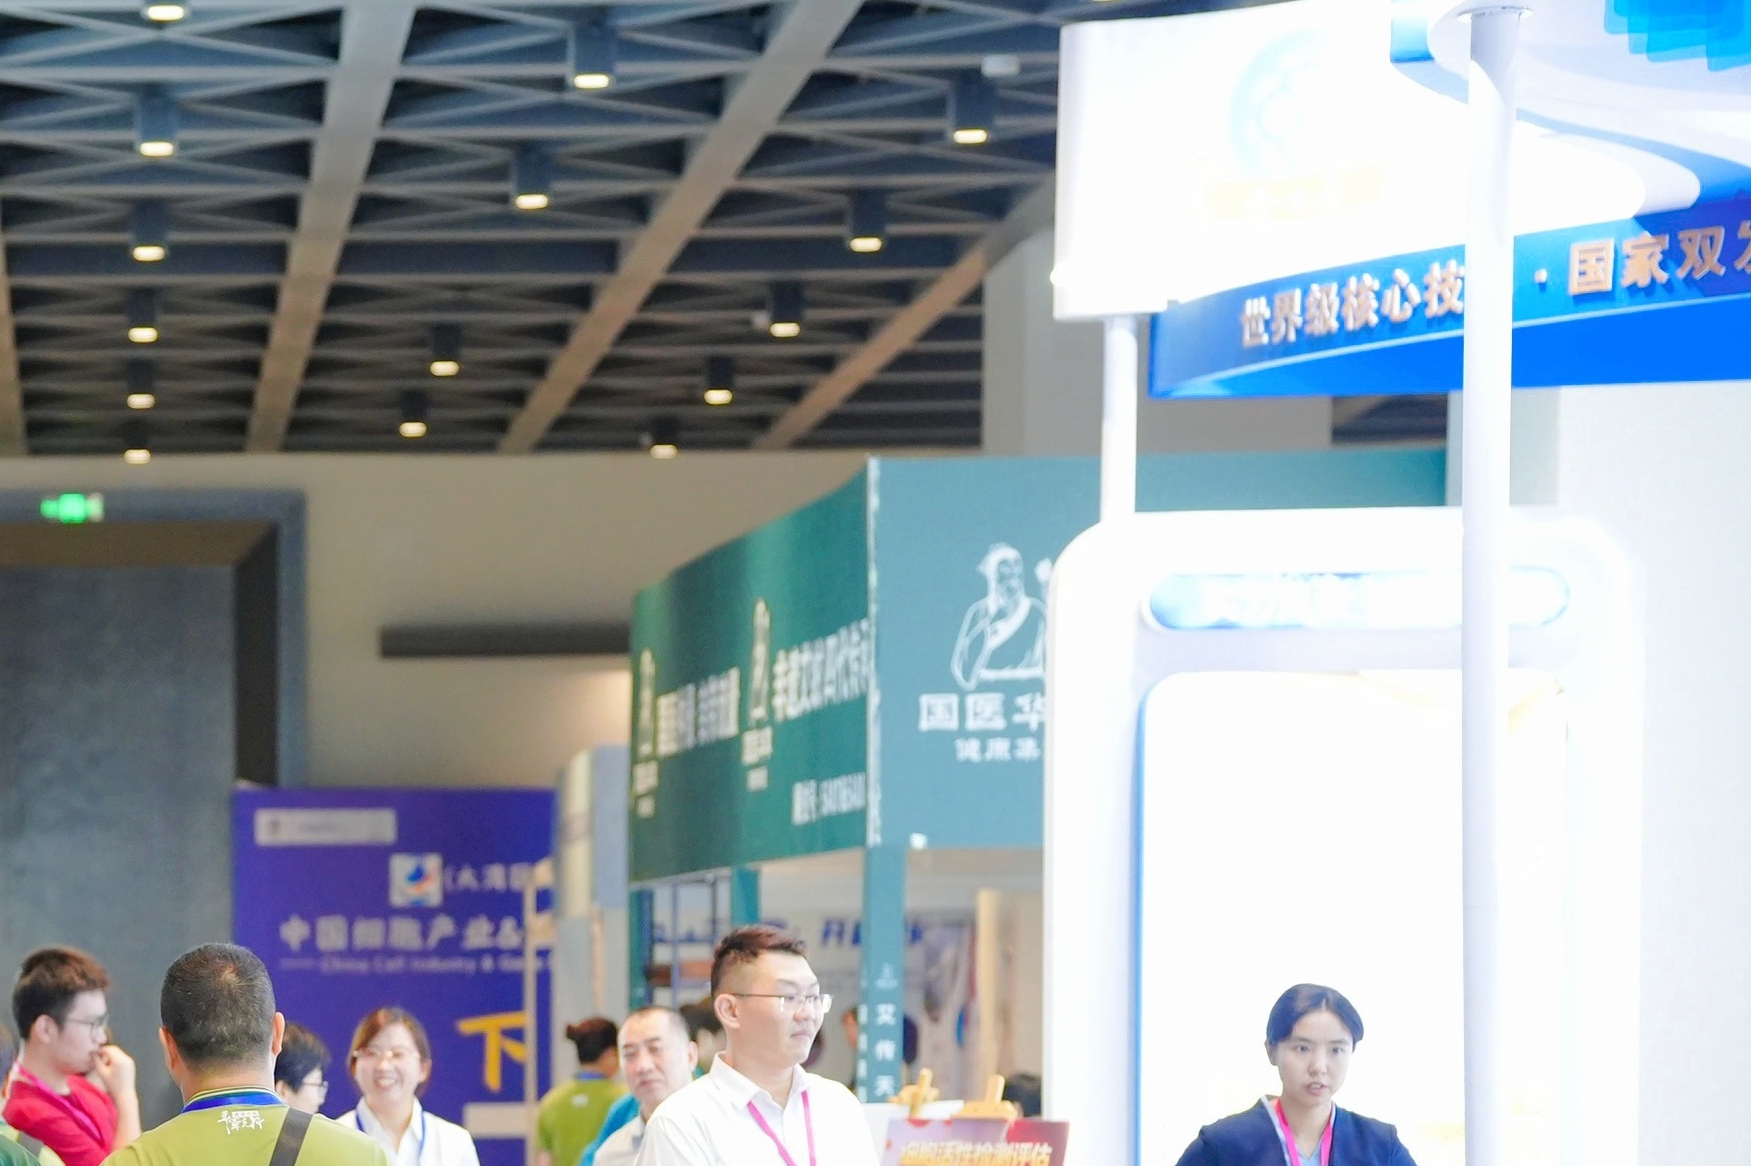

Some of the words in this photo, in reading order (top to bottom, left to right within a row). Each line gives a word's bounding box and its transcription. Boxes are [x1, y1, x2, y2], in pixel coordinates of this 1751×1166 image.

[1240, 258, 1464, 347] 世界级核心技
